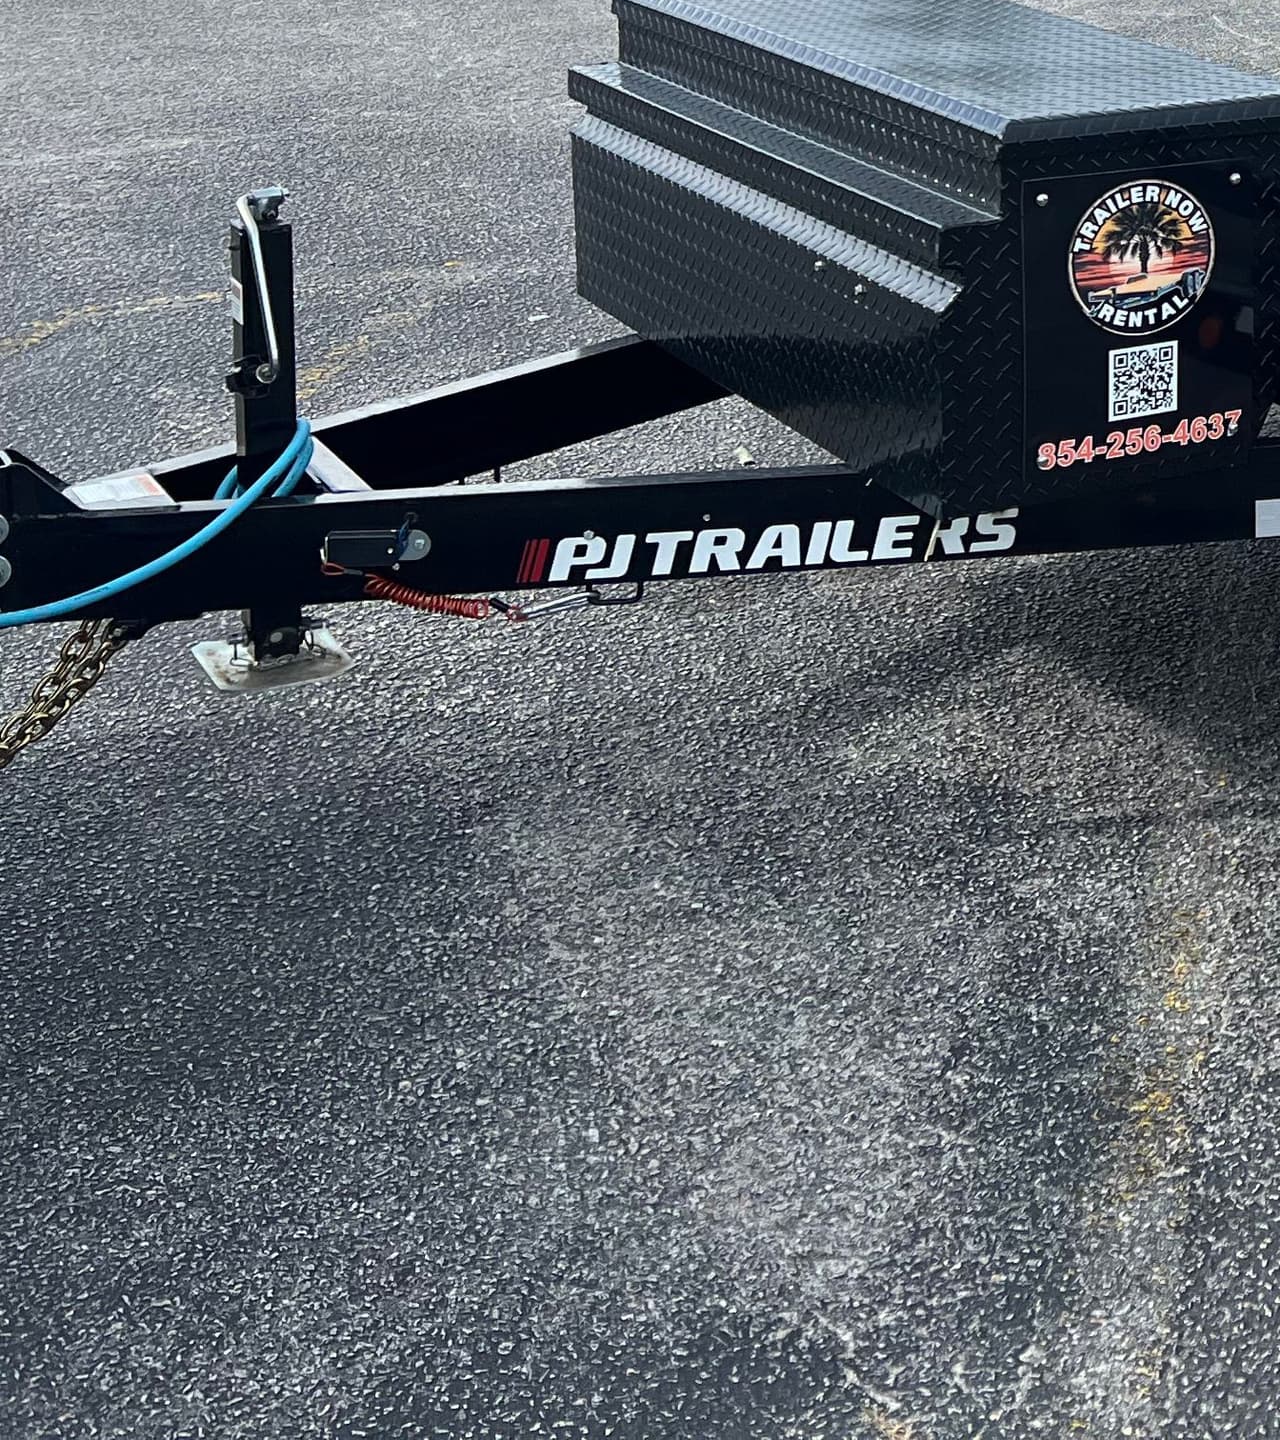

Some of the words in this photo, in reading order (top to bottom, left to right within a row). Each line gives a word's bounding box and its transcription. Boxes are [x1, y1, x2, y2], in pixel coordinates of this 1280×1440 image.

[1073, 185, 1161, 254] TRAILER
[1164, 190, 1208, 234] NOW
[1098, 295, 1190, 328] RENTAL
[1037, 409, 1242, 471] 854-256-4637
